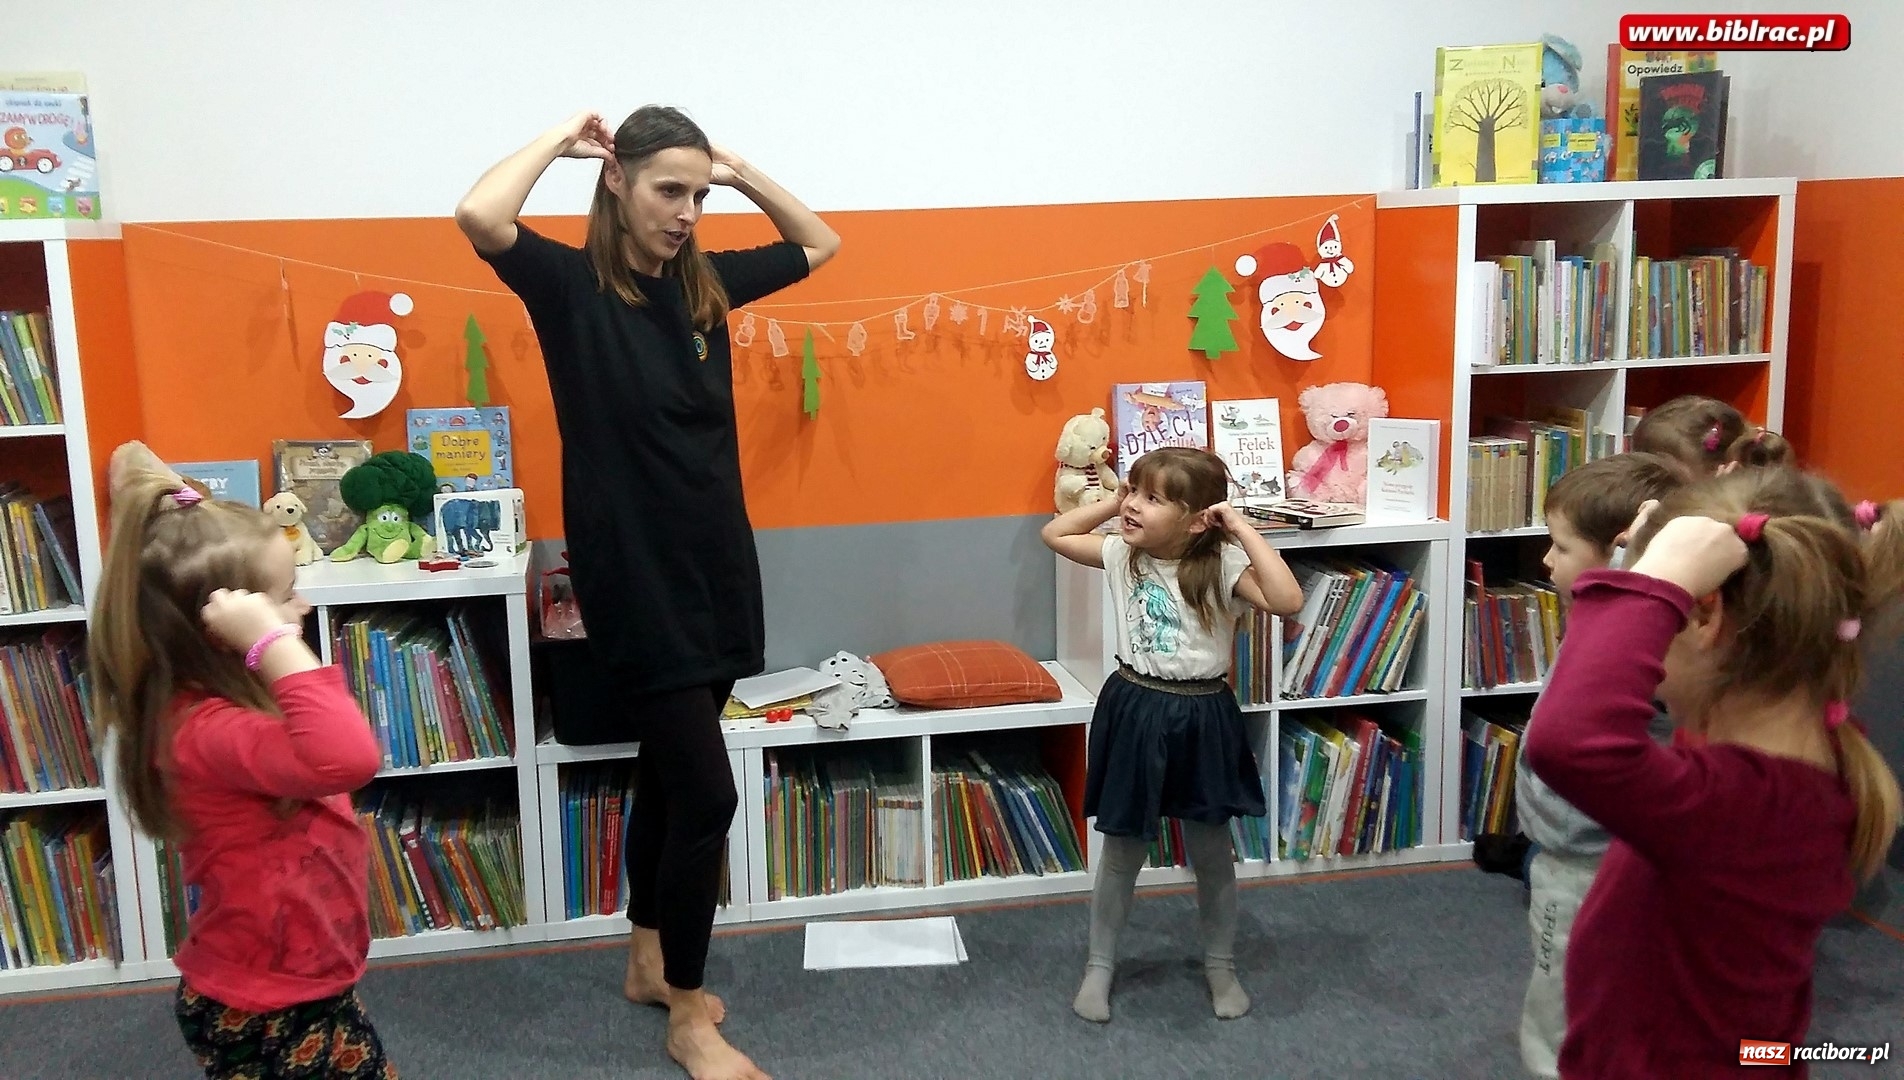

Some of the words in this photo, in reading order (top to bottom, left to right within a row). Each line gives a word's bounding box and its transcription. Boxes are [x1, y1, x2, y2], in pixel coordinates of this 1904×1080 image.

[1627, 64, 1683, 76] Opowiedz
[441, 434, 479, 447] Dobre
[1237, 436, 1276, 451] Felek
[436, 450, 486, 461] maniery
[1230, 451, 1264, 466] Tola
